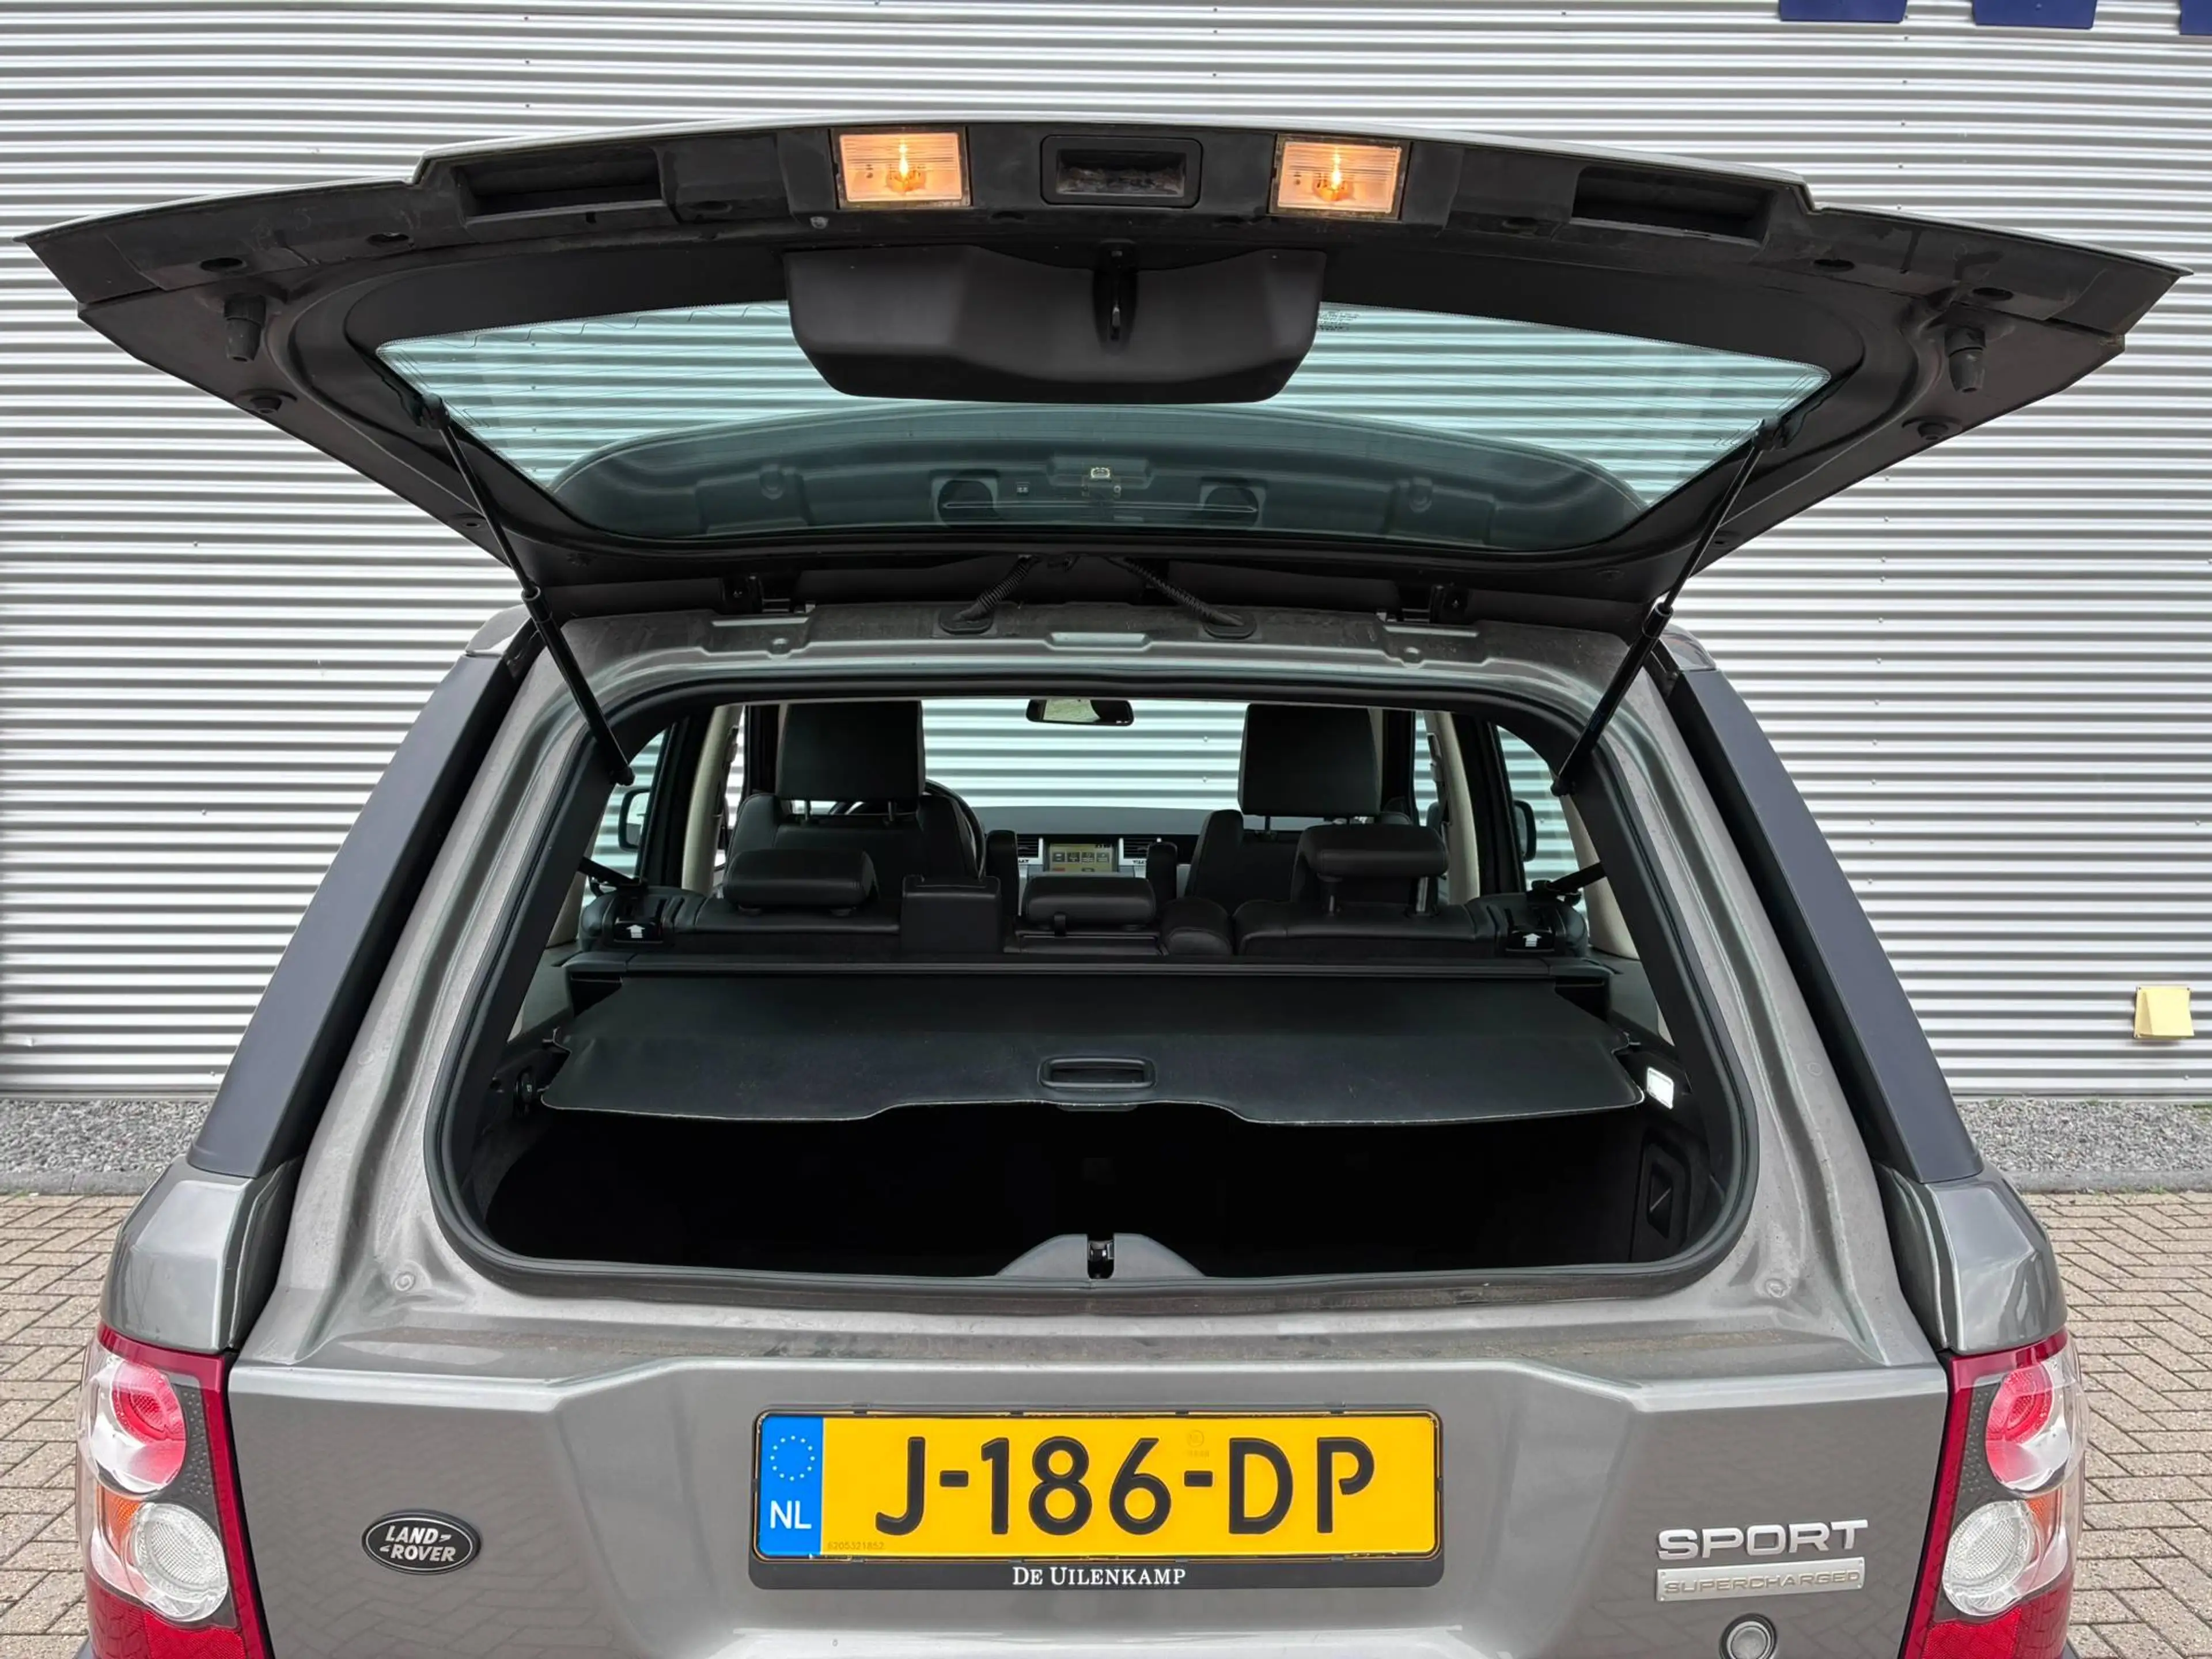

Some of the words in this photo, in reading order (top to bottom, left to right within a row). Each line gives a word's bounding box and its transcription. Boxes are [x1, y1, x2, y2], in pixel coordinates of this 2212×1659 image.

[875, 1435, 1375, 1536] J-186-DP
[770, 1501, 812, 1530] NL
[385, 1525, 439, 1544] LAND
[1657, 1519, 1869, 1560] SPORT
[390, 1544, 456, 1562] ROVER
[1012, 1566, 1043, 1585] DE
[1050, 1566, 1186, 1585] UILENKAMP
[1664, 1570, 1861, 1594] SUPERCHARGED
